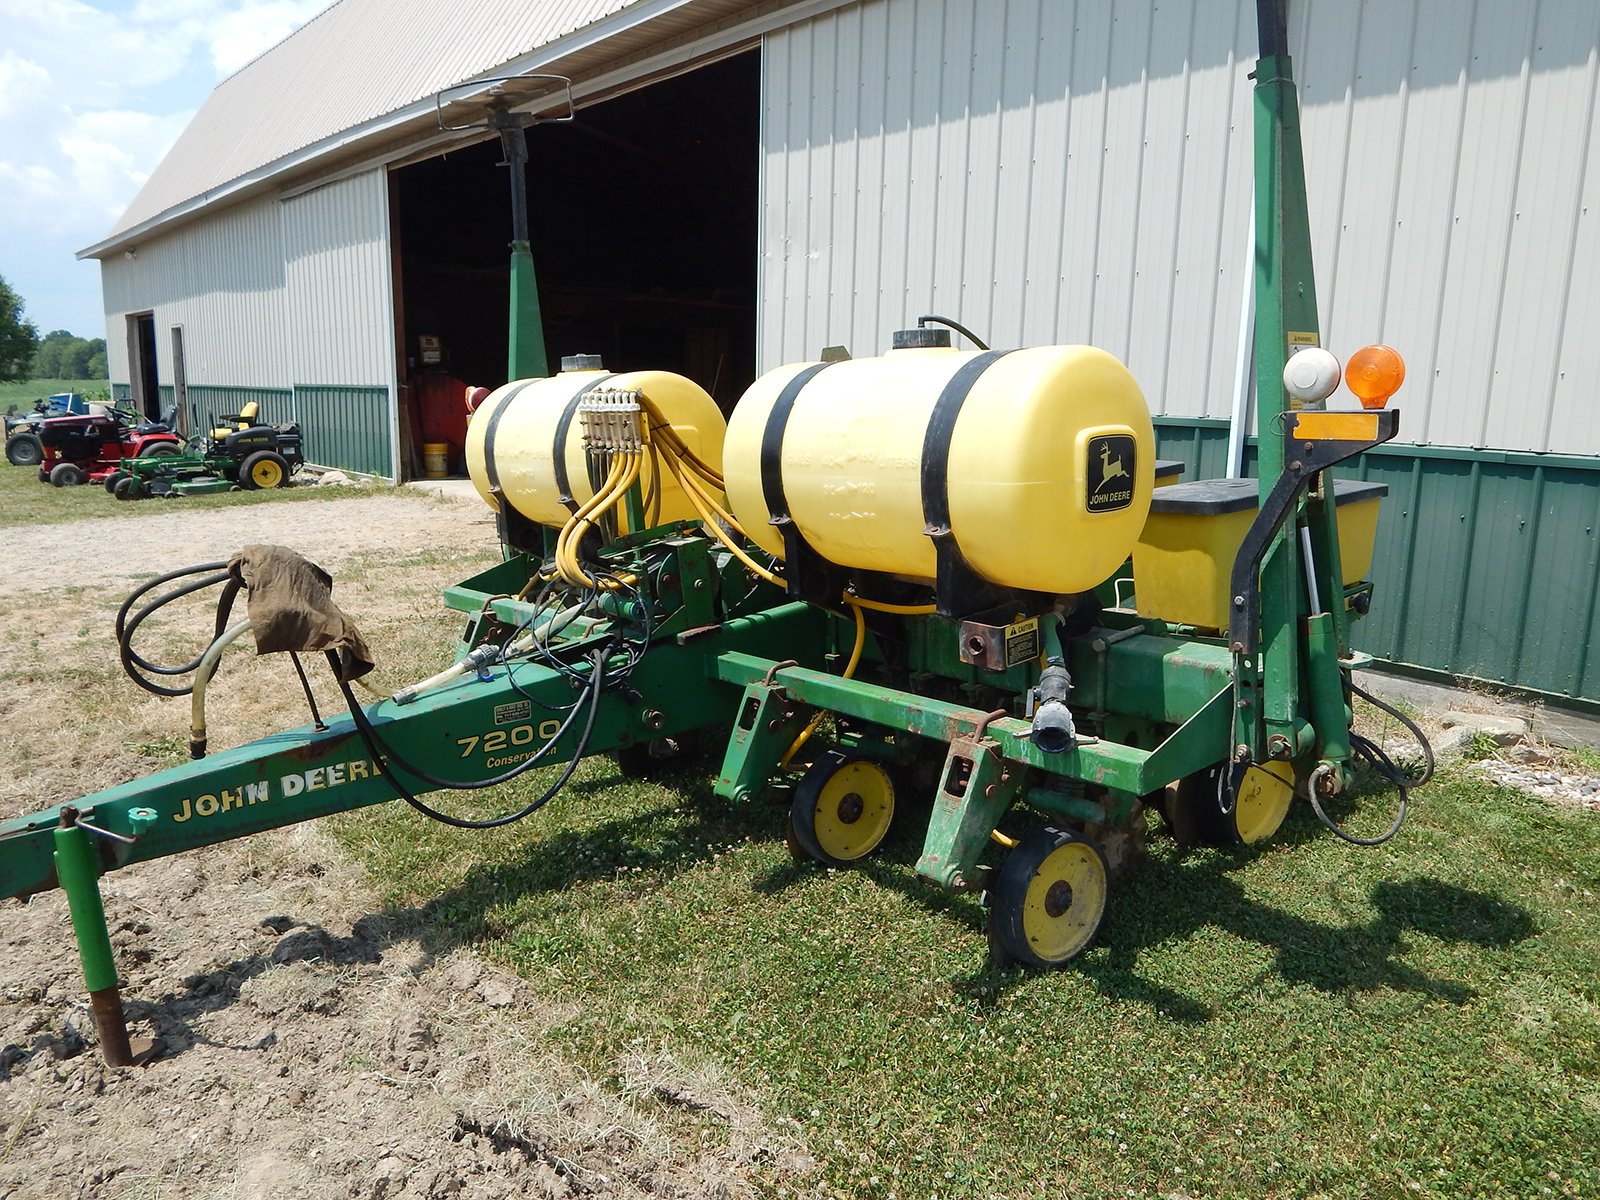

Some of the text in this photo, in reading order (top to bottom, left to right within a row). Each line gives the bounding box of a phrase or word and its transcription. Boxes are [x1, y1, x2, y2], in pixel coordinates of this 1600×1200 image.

[1089, 490, 1131, 505] JOHN DEERE
[1018, 622, 1034, 633] CAUTION
[456, 719, 562, 758] 7200
[486, 746, 557, 769] Conservan
[172, 780, 270, 823] JOHN
